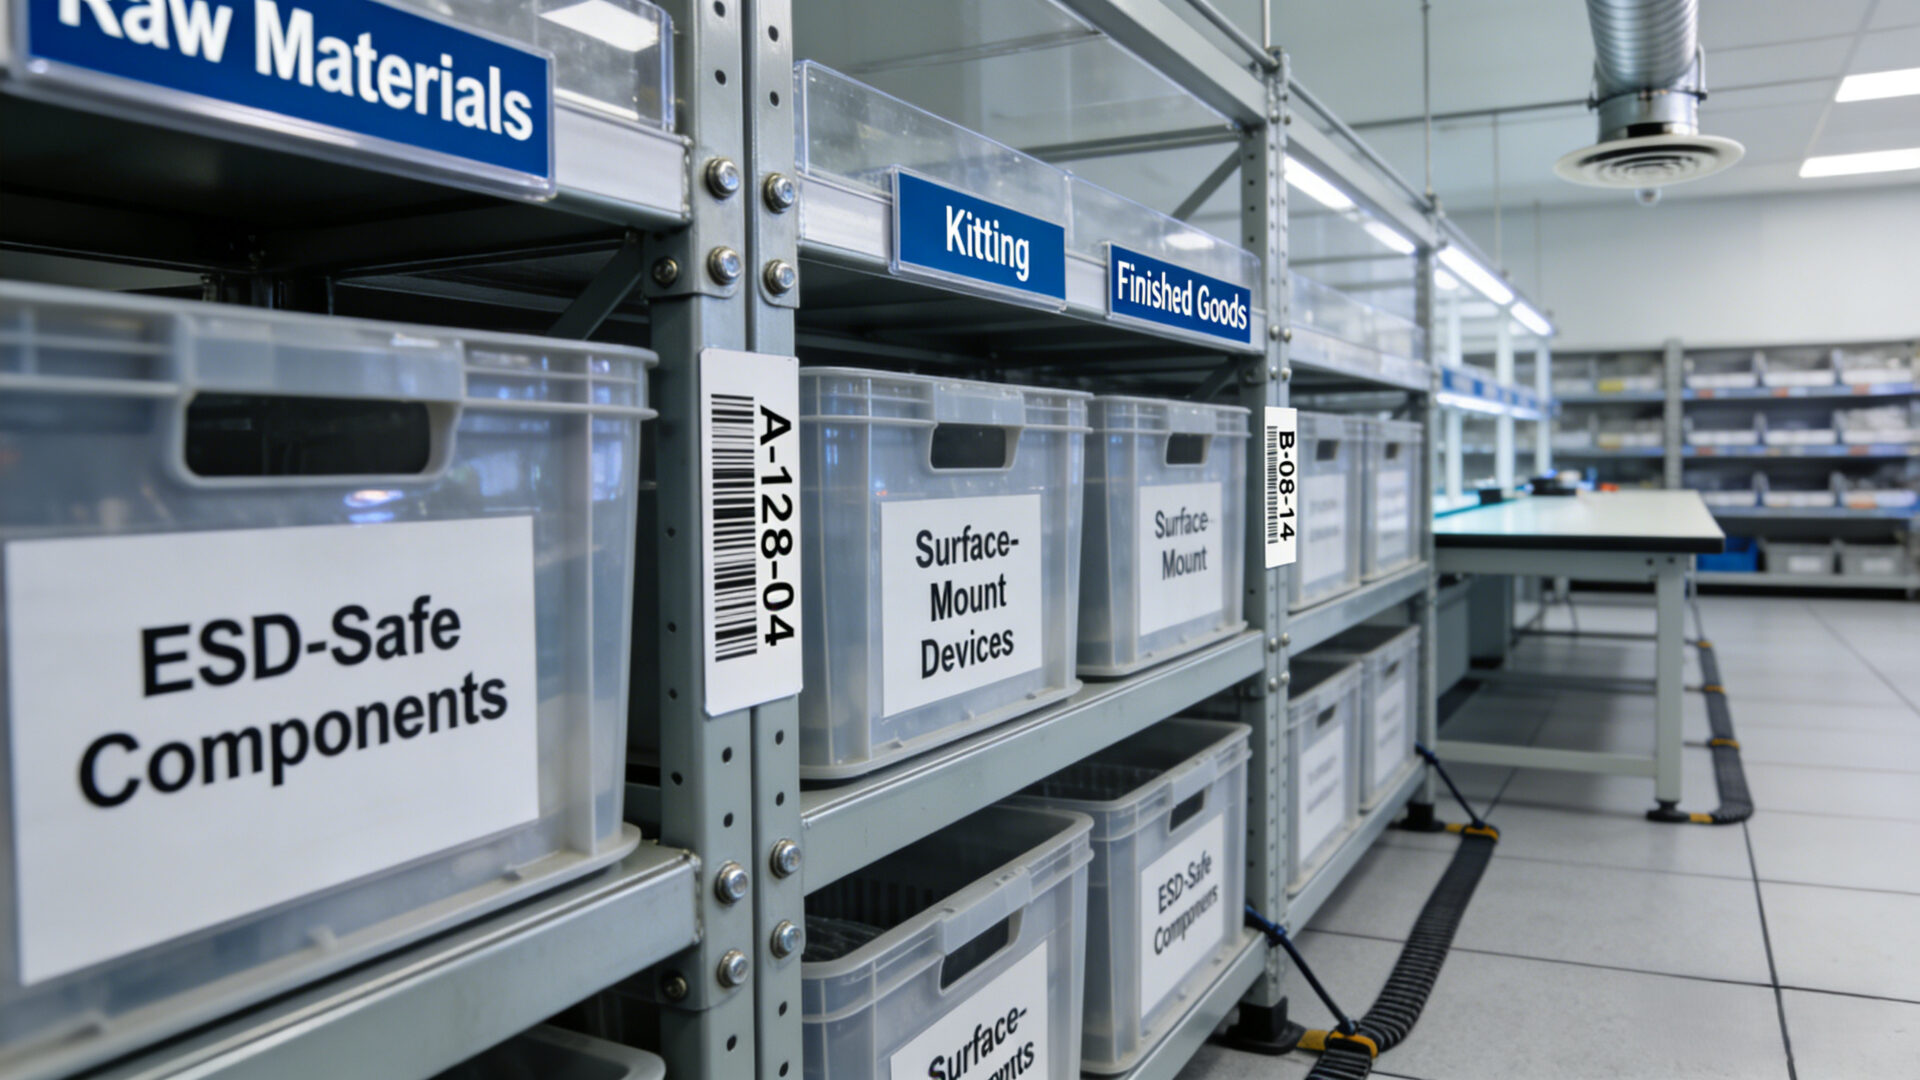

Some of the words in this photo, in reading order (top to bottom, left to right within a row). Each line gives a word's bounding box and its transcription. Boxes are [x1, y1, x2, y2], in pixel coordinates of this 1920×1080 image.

[255, 0, 534, 141] Materials
[945, 205, 1030, 282] Kitting
[1117, 260, 1192, 317] Finished
[1197, 285, 1247, 330] Goods
[1278, 431, 1295, 541] B-08-14
[760, 404, 795, 647] A-128-04
[915, 524, 1019, 568] Surface-
[930, 573, 1007, 622] Mount
[1162, 546, 1208, 581] Mount
[141, 594, 462, 698] ESD-Safe
[921, 629, 1014, 679] Devices
[77, 671, 509, 808] Components
[928, 1007, 1027, 1080] Surface-
